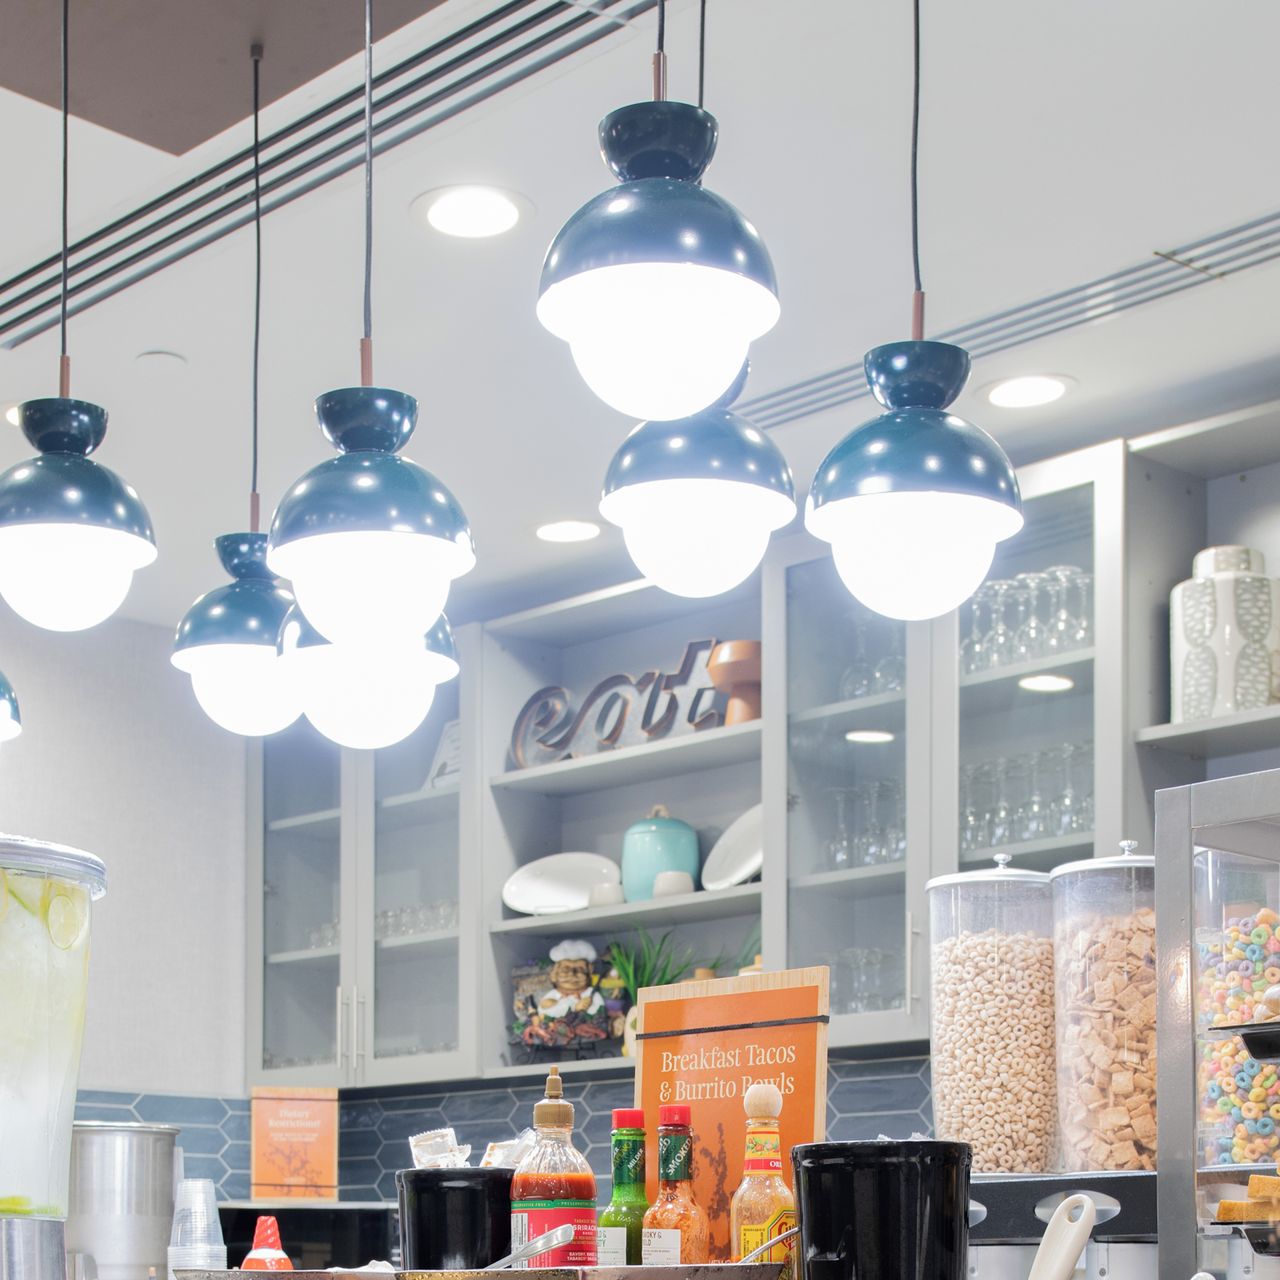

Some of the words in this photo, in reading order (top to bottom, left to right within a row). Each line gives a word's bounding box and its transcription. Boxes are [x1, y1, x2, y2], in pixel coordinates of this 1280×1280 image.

[661, 1046, 741, 1073] Breakfast
[745, 1044, 796, 1066] Tacos
[659, 1081, 672, 1102] &
[674, 1076, 737, 1101] Burrito
[666, 1138, 692, 1176] SMOKED
